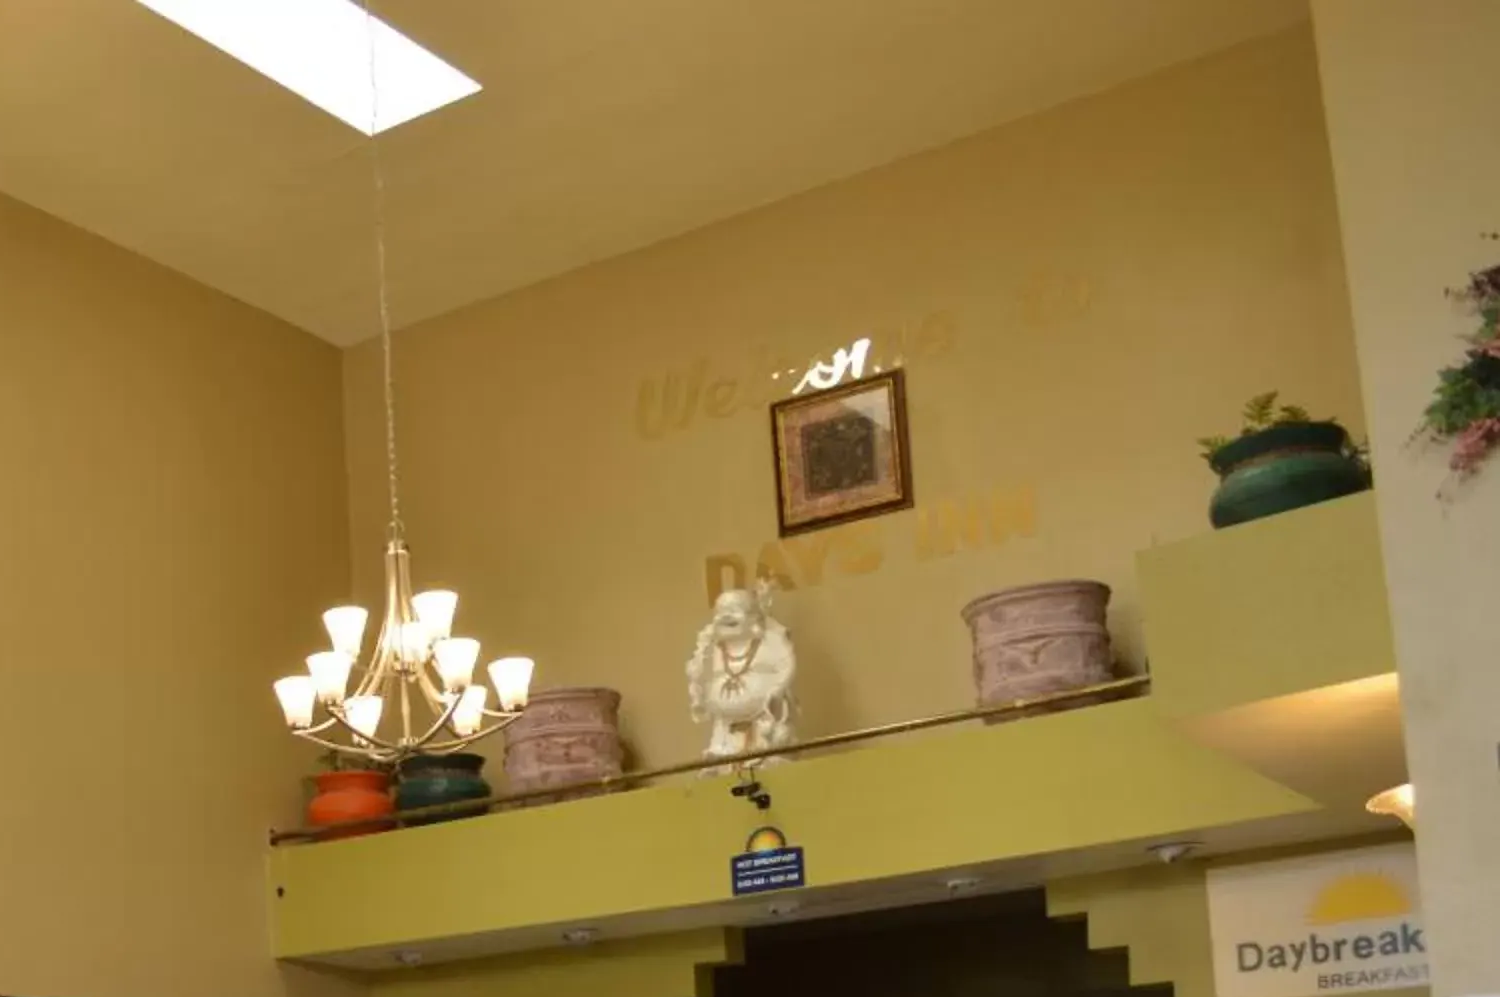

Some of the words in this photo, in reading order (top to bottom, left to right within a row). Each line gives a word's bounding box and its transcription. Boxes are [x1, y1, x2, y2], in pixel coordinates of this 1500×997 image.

[706, 527, 882, 609] DAYS
[914, 486, 1037, 564] INN
[1237, 922, 1426, 972] Daybreak
